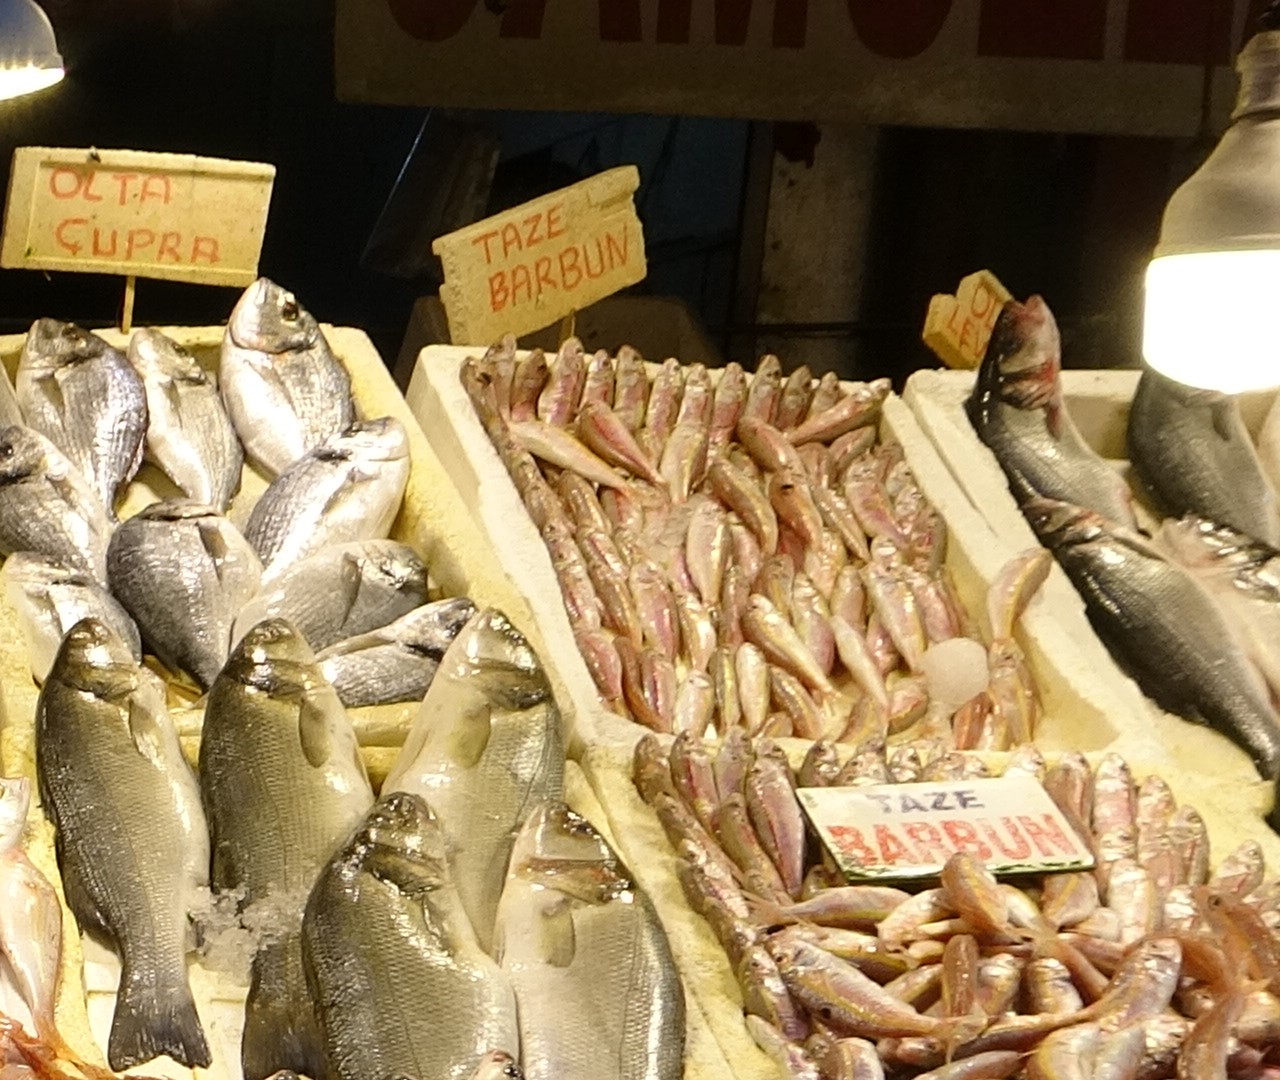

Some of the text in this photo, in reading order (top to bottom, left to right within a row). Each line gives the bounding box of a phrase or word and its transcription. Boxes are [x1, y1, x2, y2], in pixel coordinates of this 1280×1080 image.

[49, 166, 172, 206] OLTA
[471, 203, 567, 265] TAZE
[488, 221, 629, 313] BARBUN
[865, 789, 986, 814] TAZE
[825, 813, 1080, 866] BARBUN
